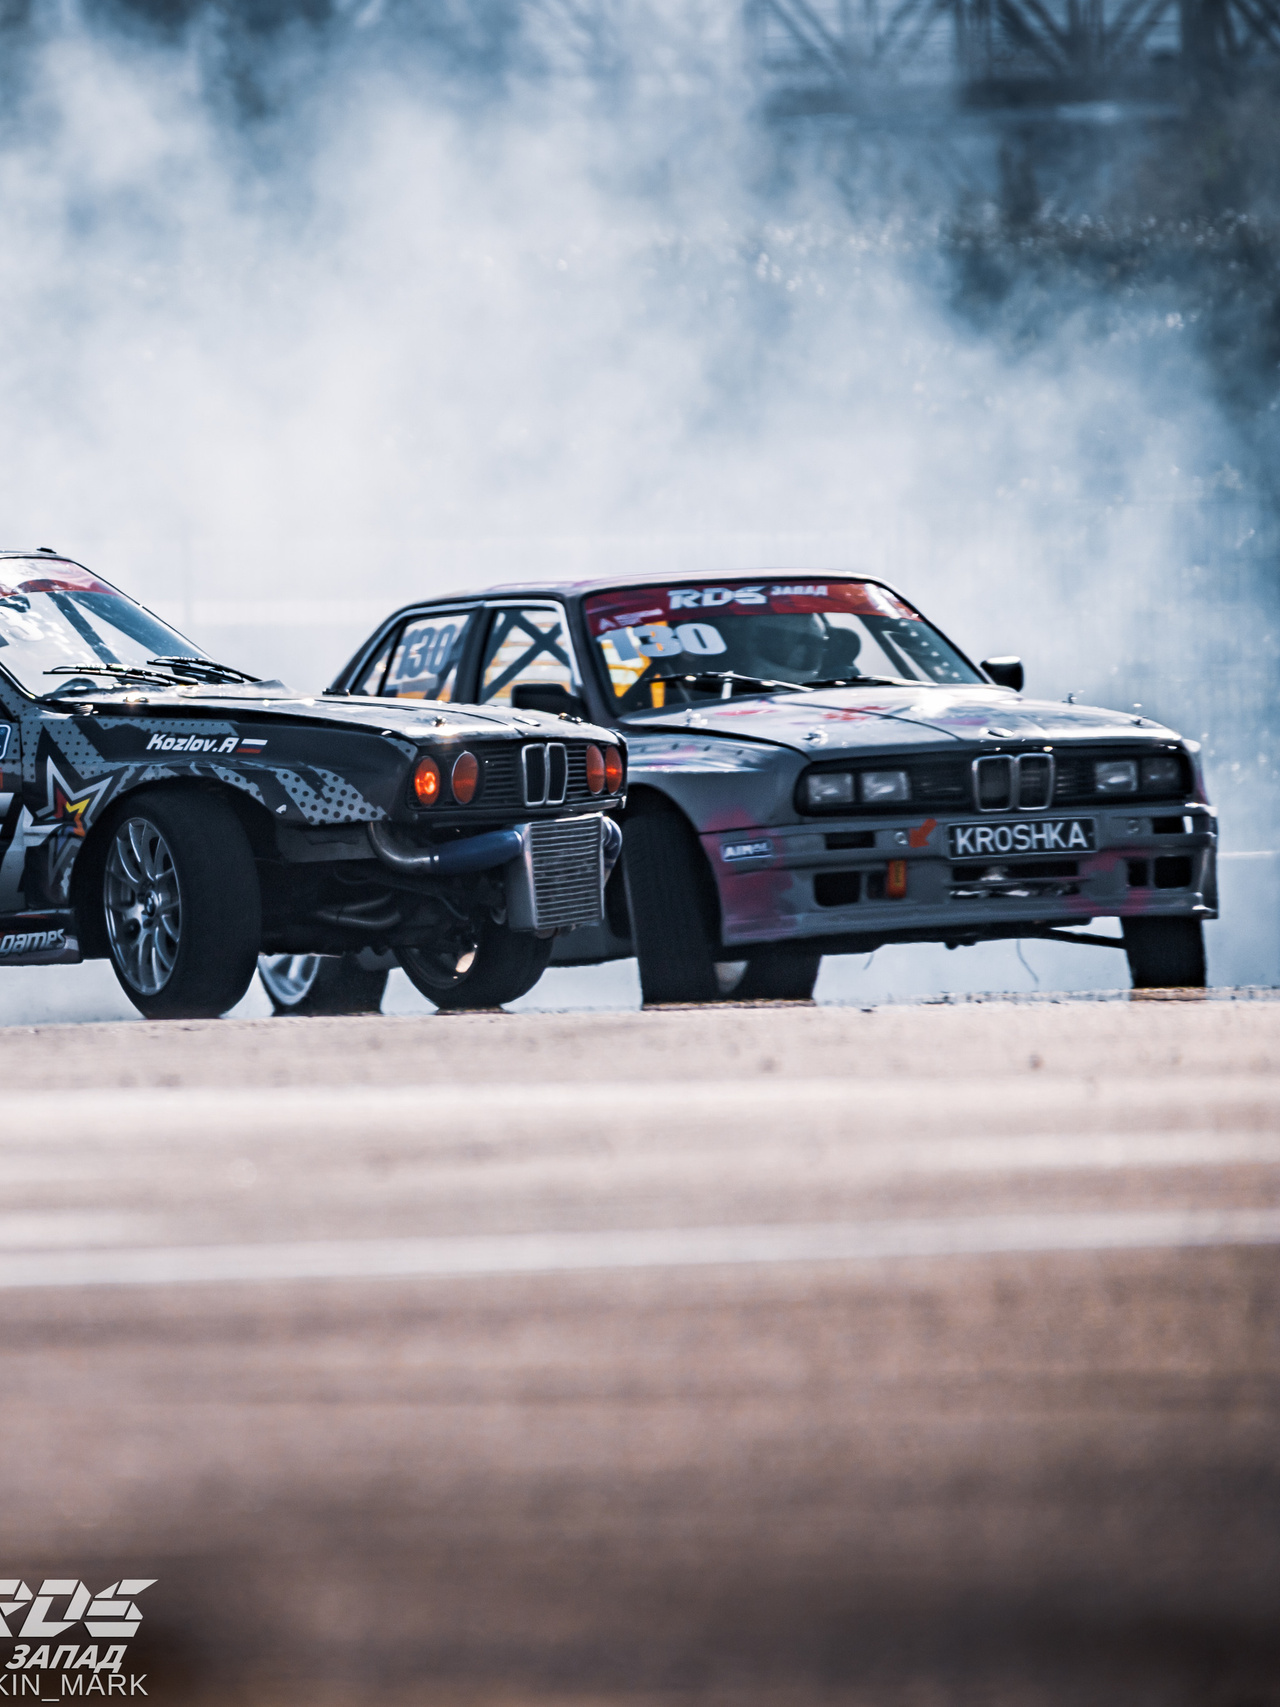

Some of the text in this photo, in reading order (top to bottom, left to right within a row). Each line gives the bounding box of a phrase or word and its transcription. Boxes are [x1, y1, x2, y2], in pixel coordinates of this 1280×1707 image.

[667, 586, 767, 610] RDS
[395, 624, 457, 680] 130
[596, 623, 727, 661] 130
[146, 733, 240, 753] Kozlov.A
[955, 821, 1088, 855] KROSHKA
